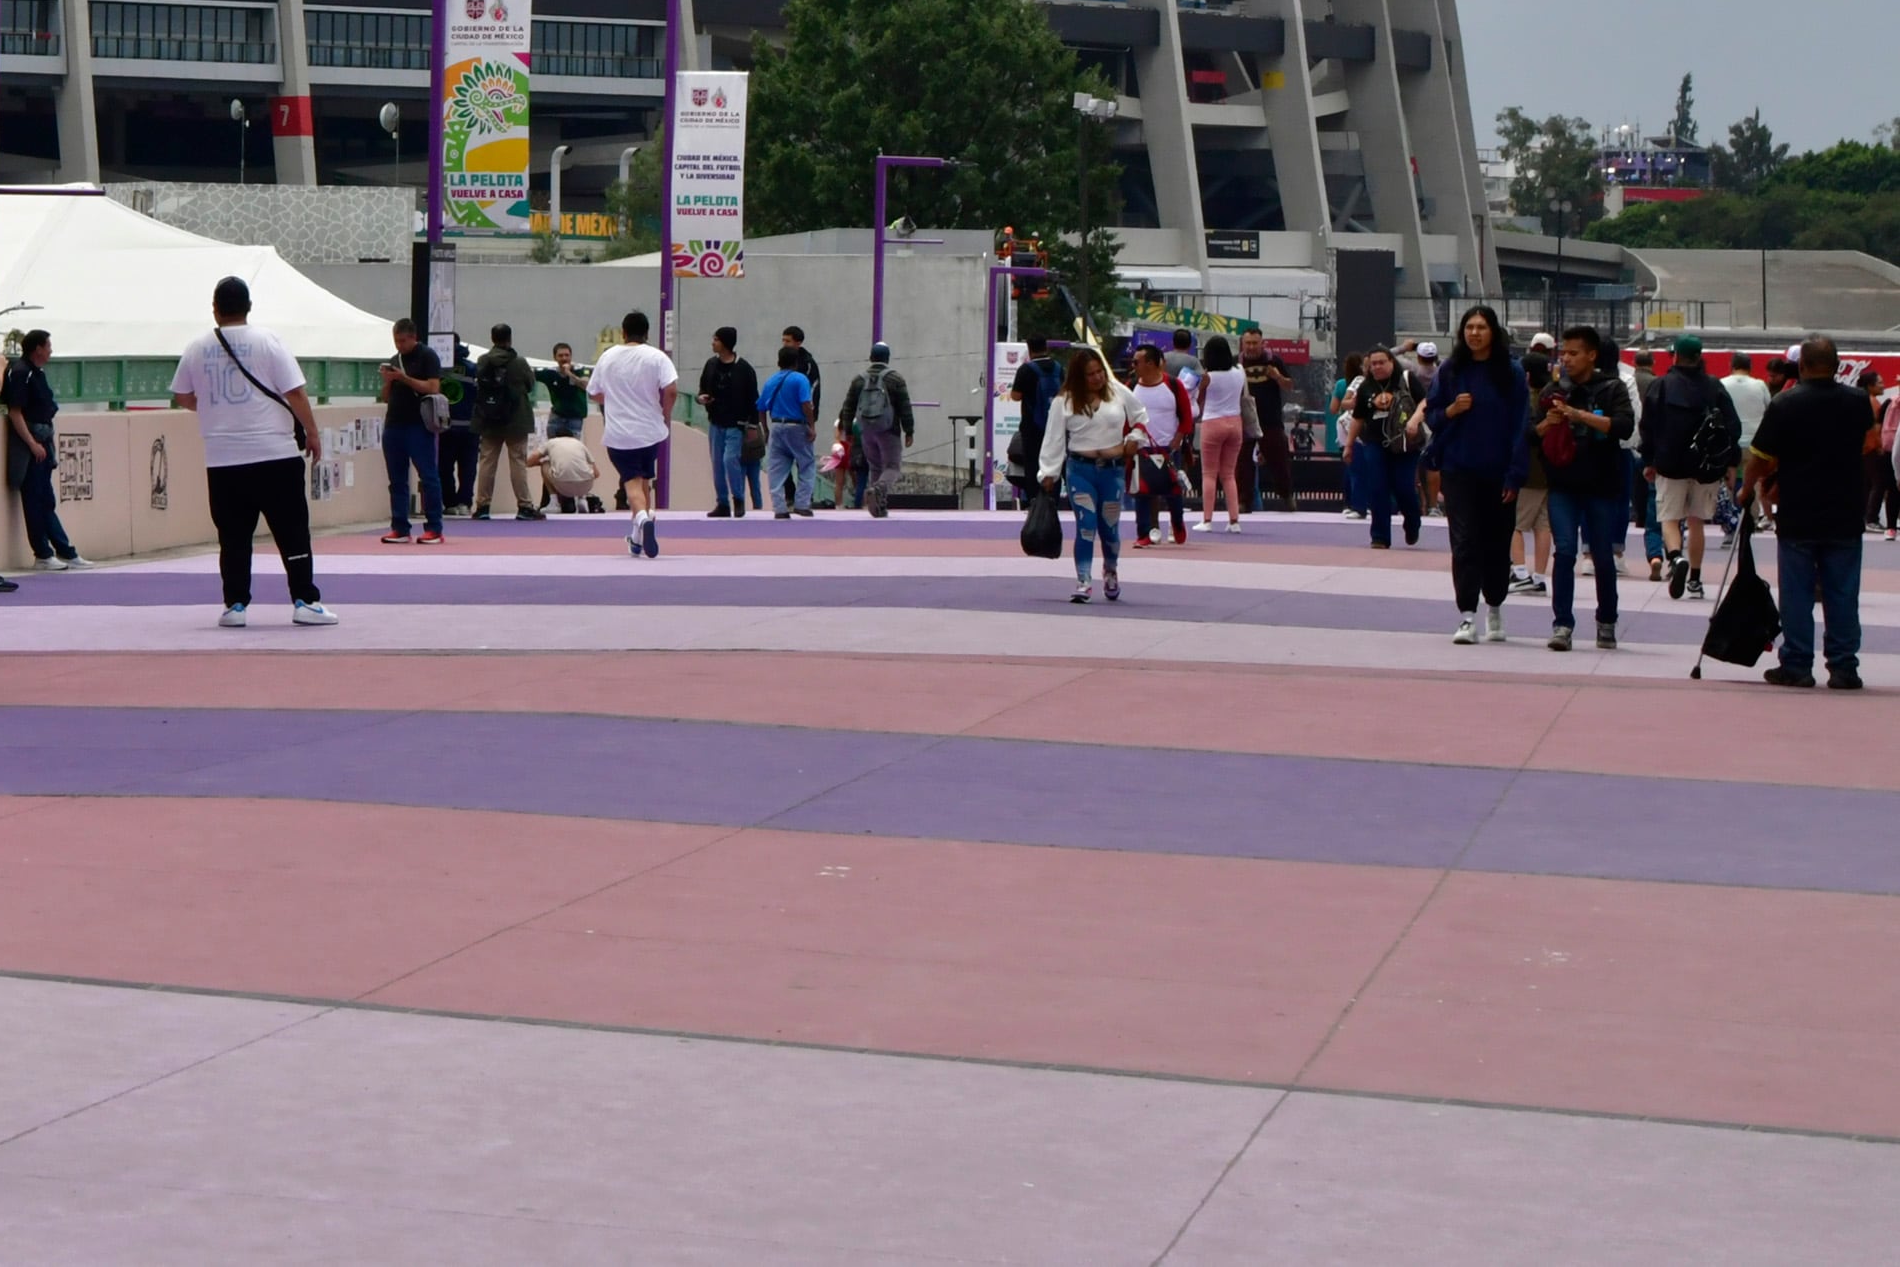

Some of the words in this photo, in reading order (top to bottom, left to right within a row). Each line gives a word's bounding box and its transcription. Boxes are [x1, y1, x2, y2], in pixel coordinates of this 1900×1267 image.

[494, 32, 525, 40] MÉXICO
[280, 105, 290, 127] 7
[450, 174, 467, 186] LA
[470, 174, 524, 186] PELOTA
[451, 189, 487, 198] VUELVE
[489, 189, 496, 198] A
[498, 189, 524, 198] CASA
[676, 195, 691, 206] LA
[693, 195, 738, 206] PELOTA
[676, 208, 707, 216] VUELVE
[709, 208, 715, 216] A
[716, 208, 738, 216] CASA
